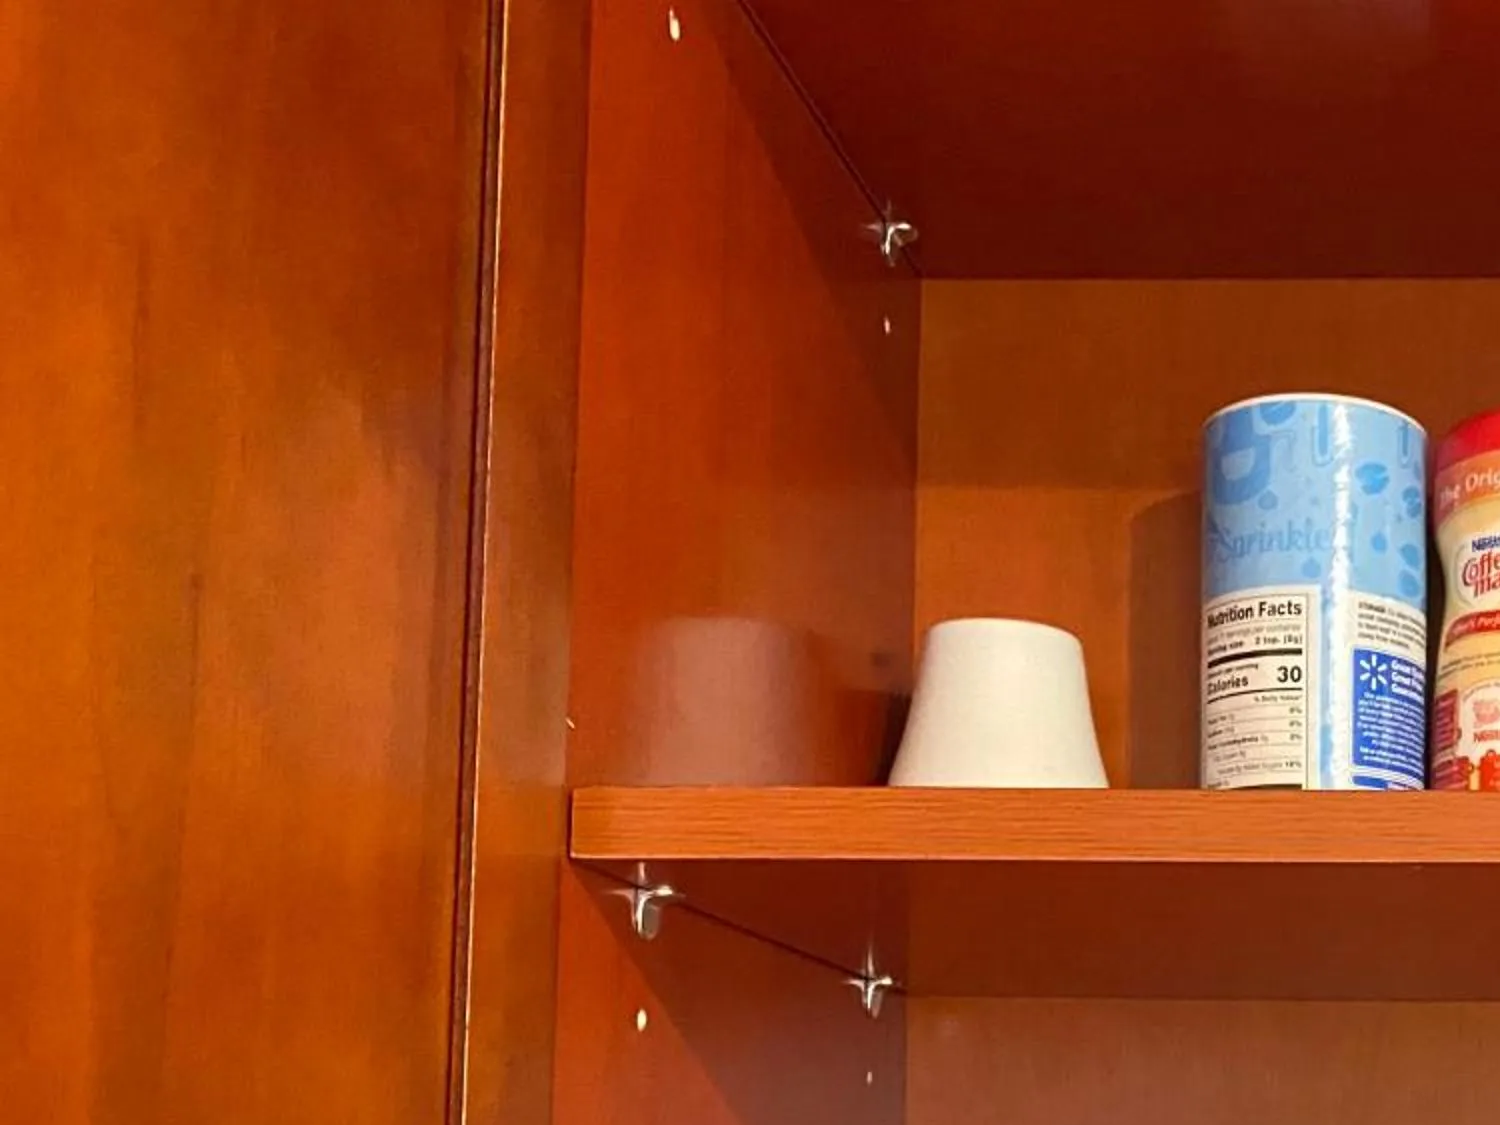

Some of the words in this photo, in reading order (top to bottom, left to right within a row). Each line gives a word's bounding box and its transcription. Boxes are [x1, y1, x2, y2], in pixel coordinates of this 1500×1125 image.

[1207, 604, 1254, 629] Nutrition
[1258, 600, 1303, 617] Facts
[1277, 665, 1303, 682] 30
